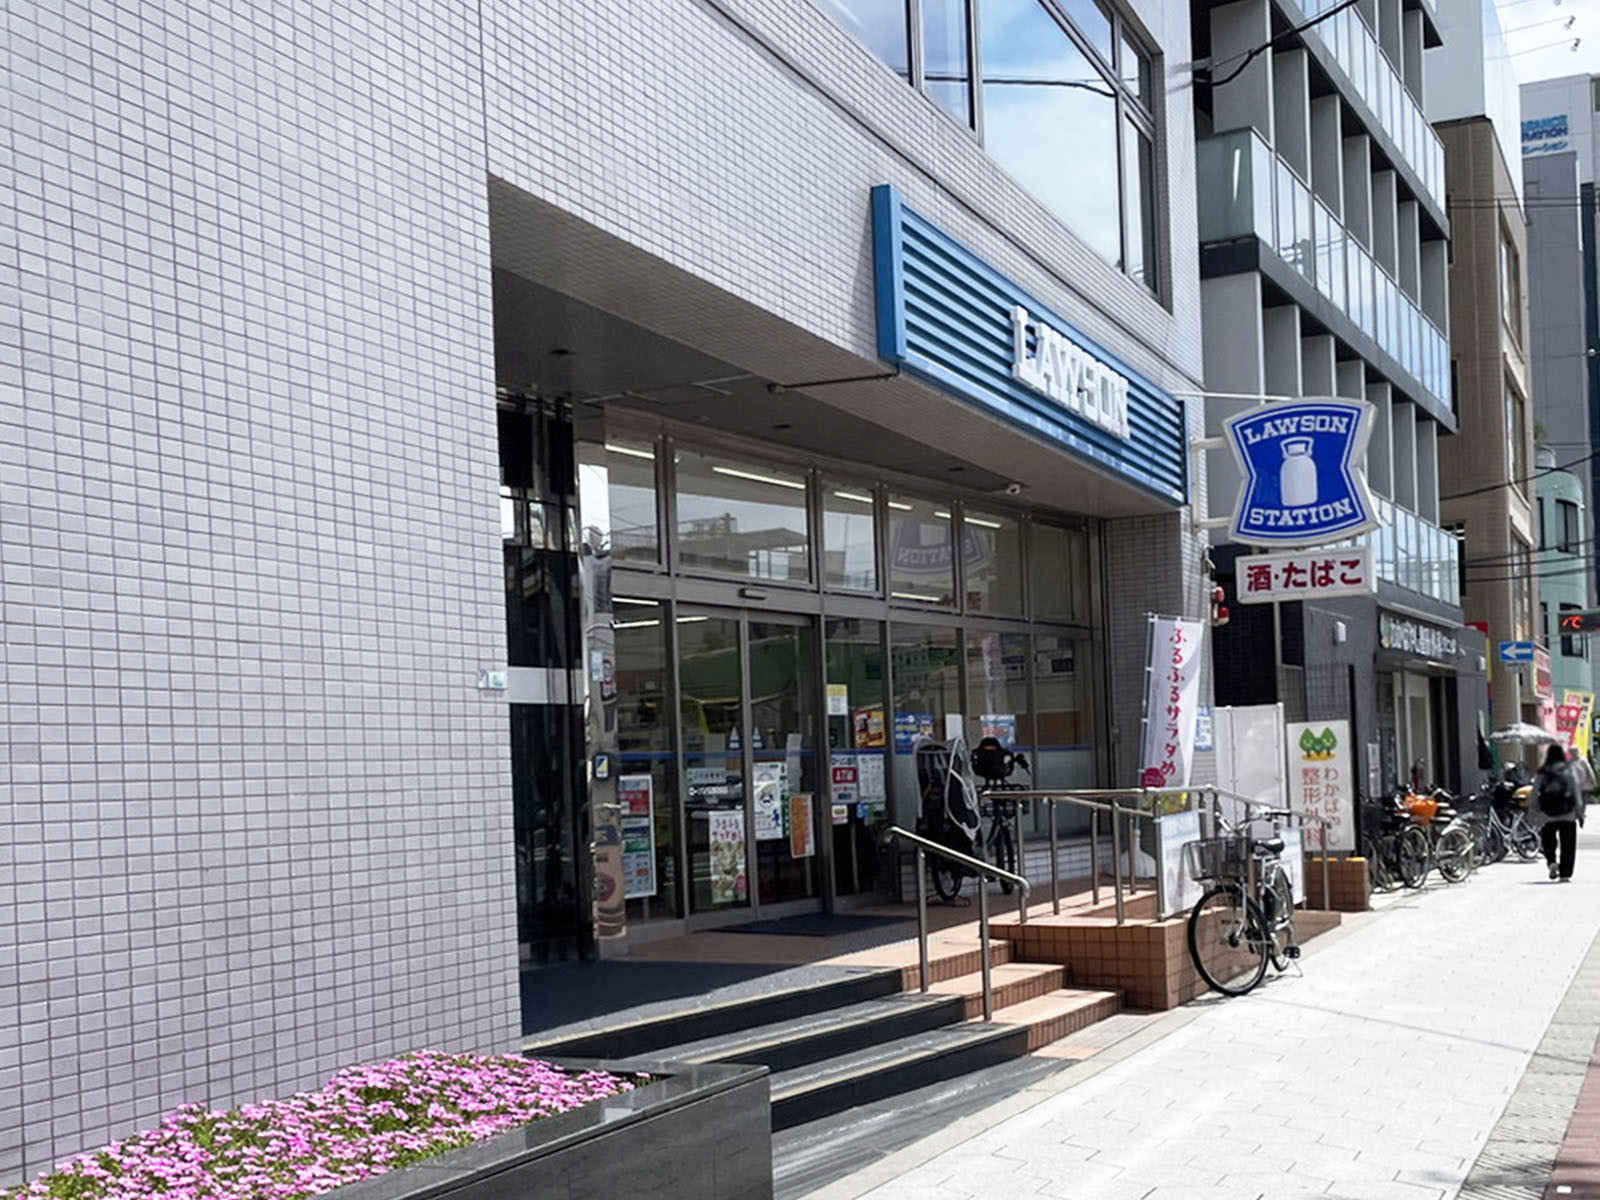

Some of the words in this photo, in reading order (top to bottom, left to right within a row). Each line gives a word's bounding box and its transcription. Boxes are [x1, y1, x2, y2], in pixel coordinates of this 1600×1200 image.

[1010, 305, 1130, 439] LAWSON
[1244, 415, 1349, 445] LAWSON
[1250, 498, 1353, 526] STATION
[1247, 559, 1362, 591] 酒・たばこ
